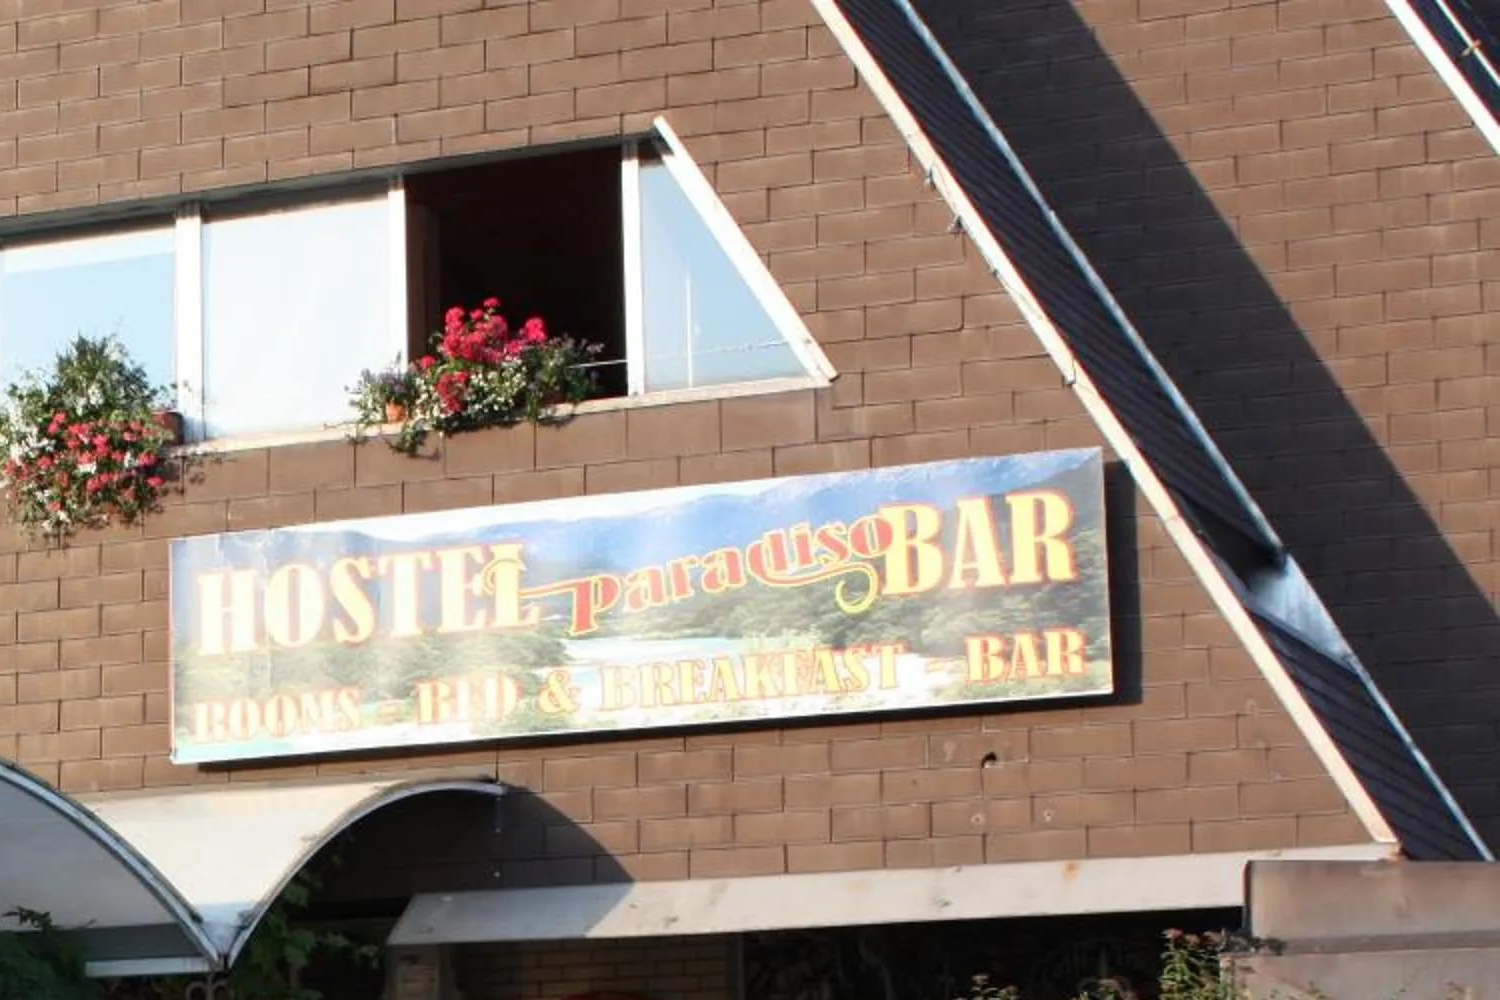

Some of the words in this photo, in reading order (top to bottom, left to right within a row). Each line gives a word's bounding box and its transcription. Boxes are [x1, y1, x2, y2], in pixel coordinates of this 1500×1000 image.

[197, 542, 541, 657] HOSTEL
[556, 513, 894, 636] Paradiso
[878, 490, 1077, 597] BAR
[193, 686, 363, 744] ROOMS
[417, 674, 520, 725] BED
[539, 669, 581, 714] &
[598, 643, 906, 712] BREAKFAST
[963, 626, 1088, 685] BAR
